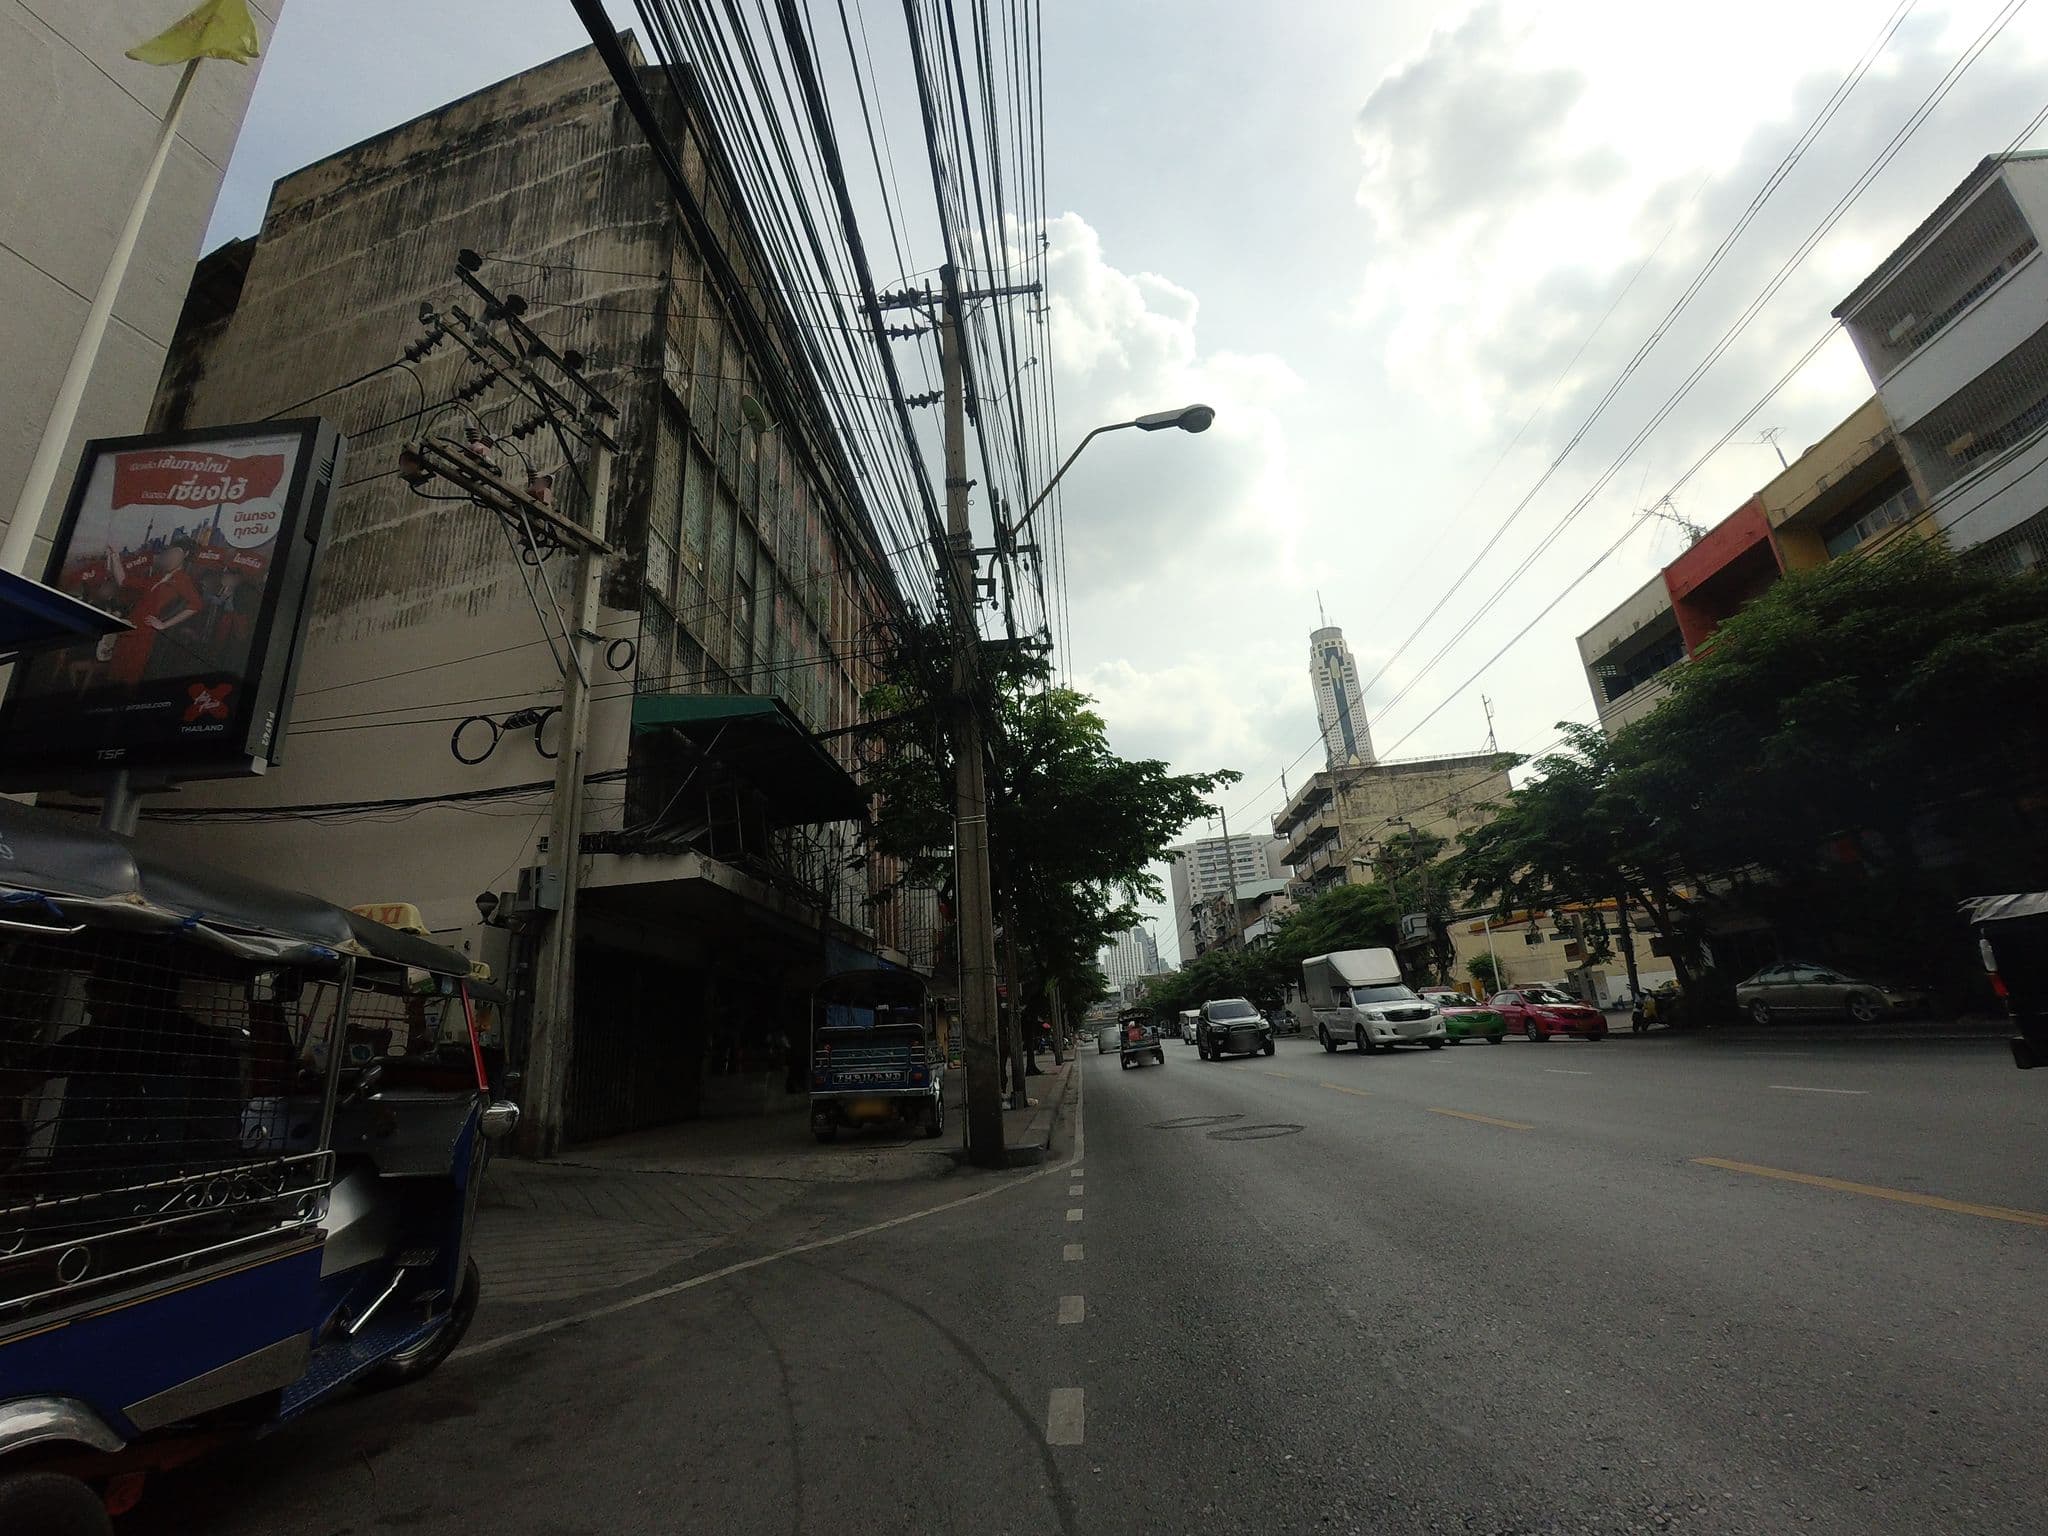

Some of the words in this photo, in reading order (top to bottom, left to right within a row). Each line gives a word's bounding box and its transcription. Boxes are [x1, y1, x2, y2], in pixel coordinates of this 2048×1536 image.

[157, 455, 232, 474] เส้นทางใหม่
[166, 474, 249, 501] เซี่ยงไฮ้
[233, 511, 276, 523] บินตรง
[233, 523, 269, 540] ทุกวัน
[180, 723, 225, 734] THAILAND
[96, 748, 128, 761] TSF
[836, 1072, 902, 1082] THAILAND
